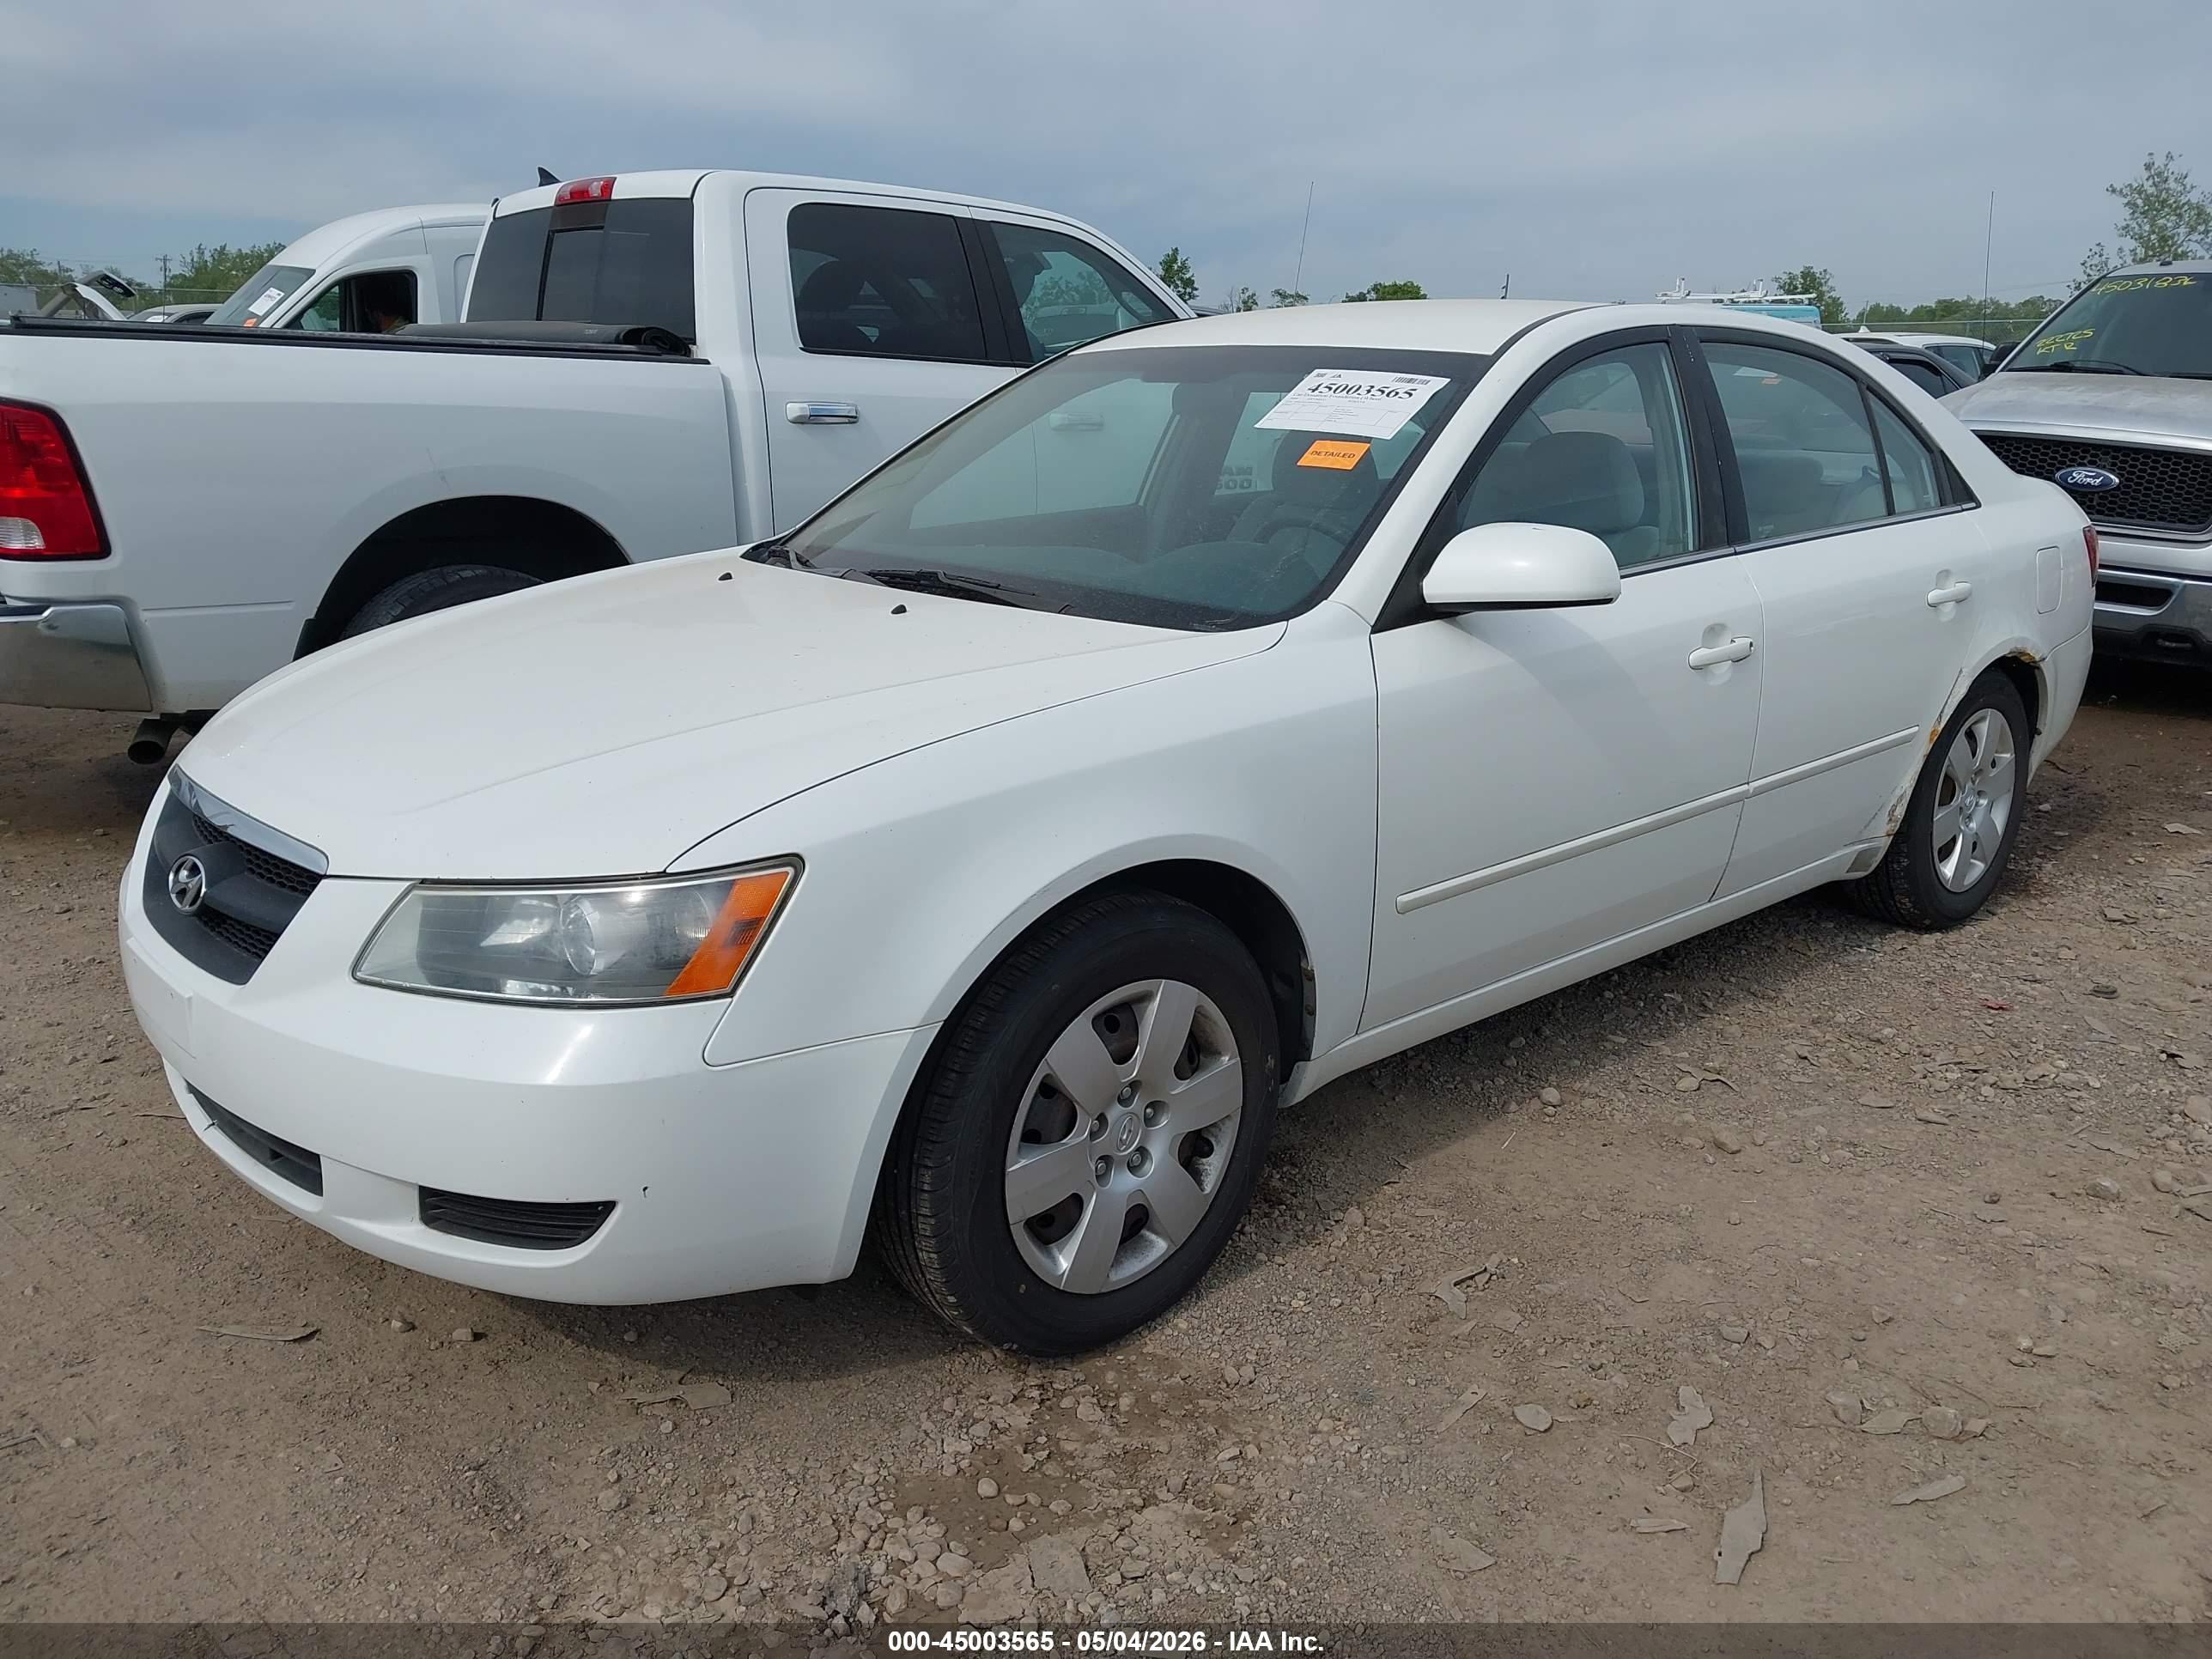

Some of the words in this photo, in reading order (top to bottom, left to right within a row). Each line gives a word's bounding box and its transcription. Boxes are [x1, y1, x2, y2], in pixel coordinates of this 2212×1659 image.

[1308, 382, 1419, 400] 45003565
[1310, 450, 1356, 459] DETAILED
[2067, 470, 2105, 486] Ford
